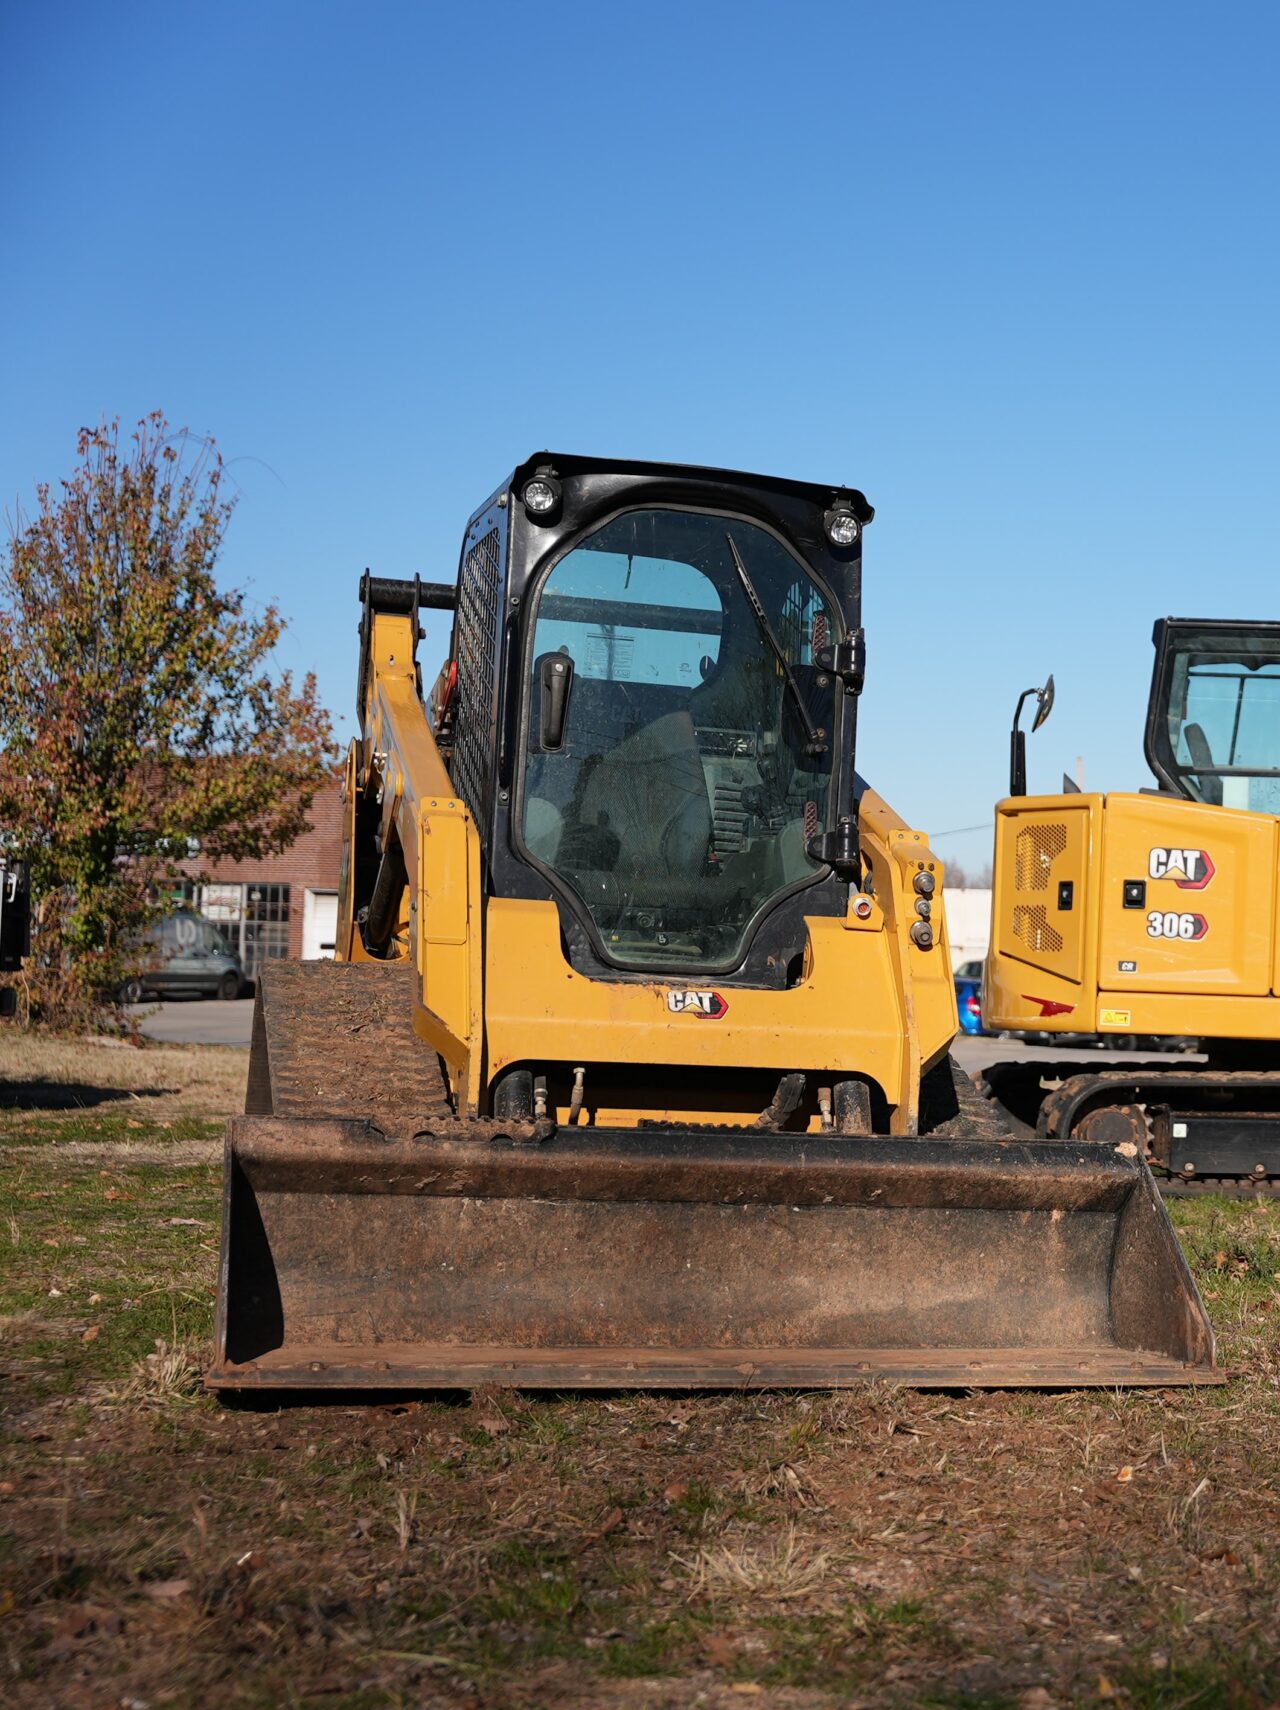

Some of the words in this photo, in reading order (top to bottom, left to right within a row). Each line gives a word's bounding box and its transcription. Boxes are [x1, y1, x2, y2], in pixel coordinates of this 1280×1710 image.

[1149, 848, 1201, 881] CAT
[1147, 911, 1195, 939] 306
[1121, 962, 1134, 971] CR
[668, 991, 713, 1014] CAT
